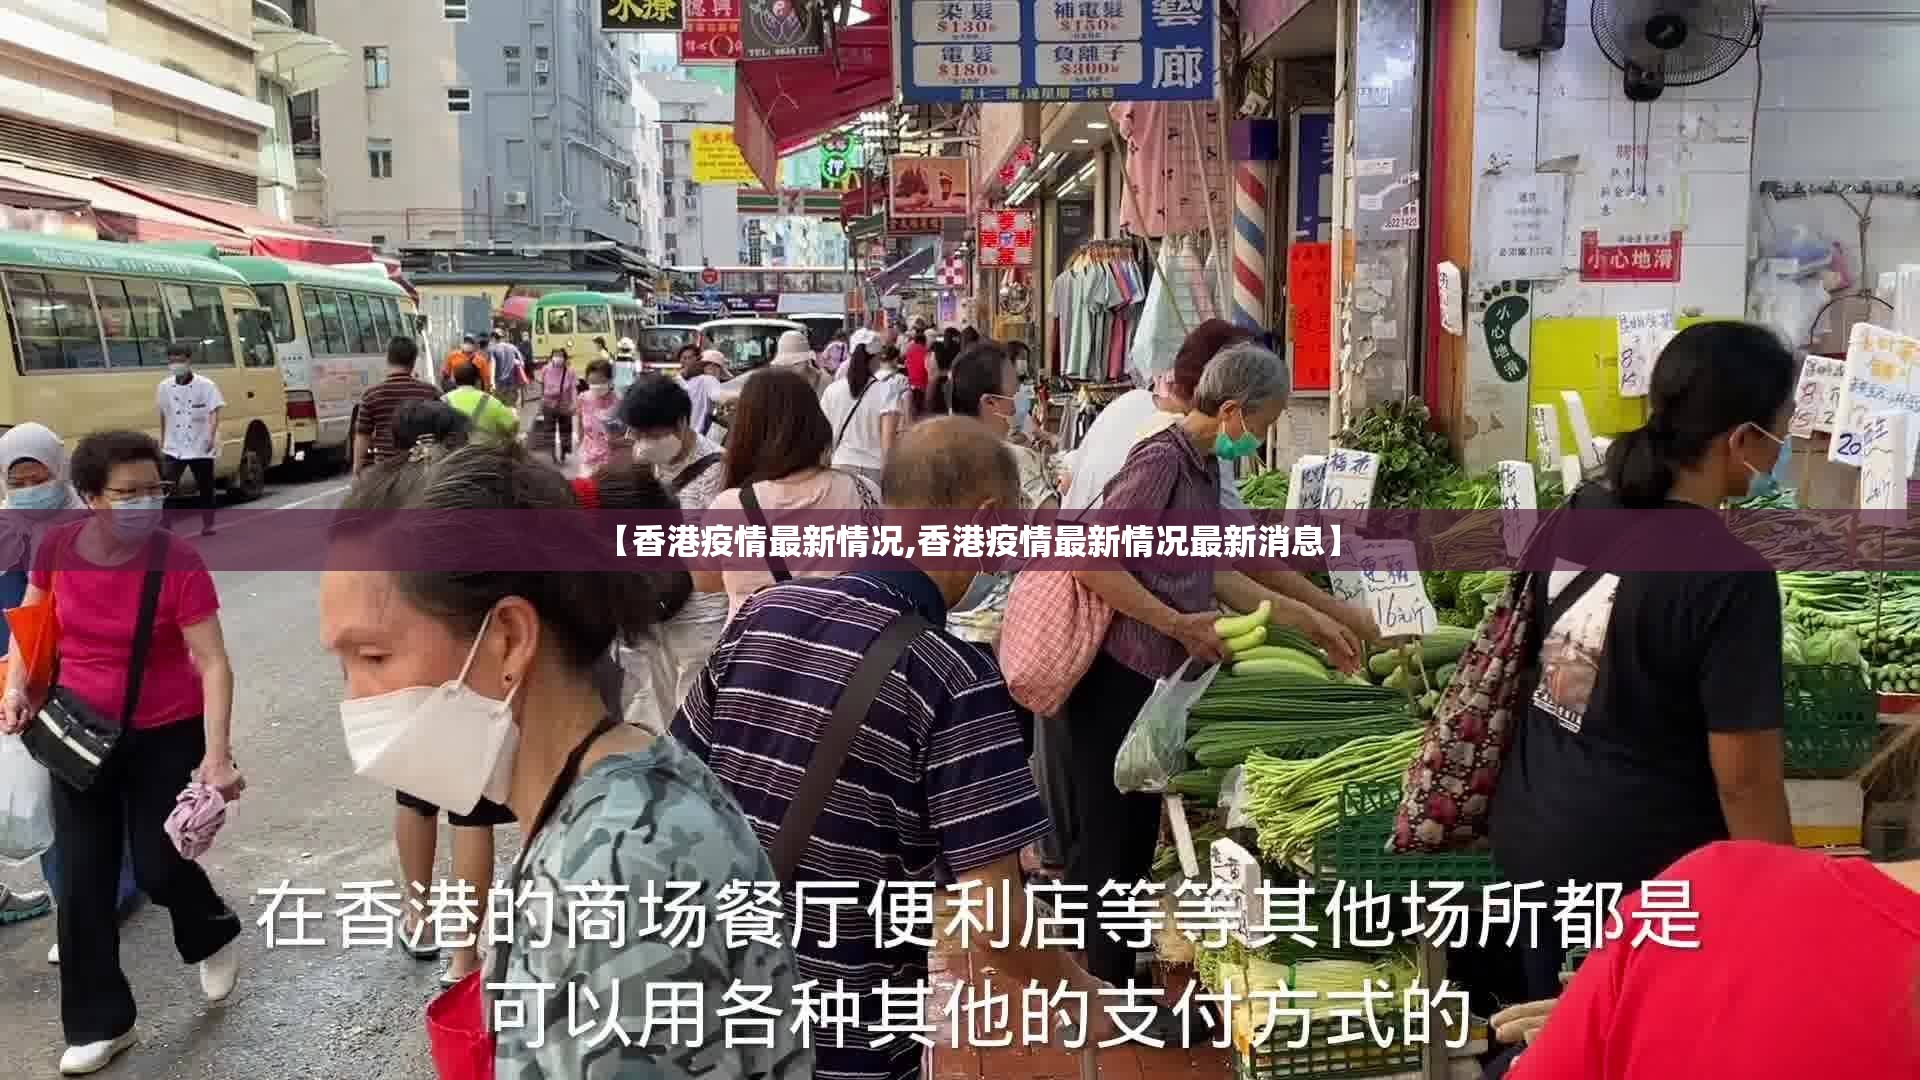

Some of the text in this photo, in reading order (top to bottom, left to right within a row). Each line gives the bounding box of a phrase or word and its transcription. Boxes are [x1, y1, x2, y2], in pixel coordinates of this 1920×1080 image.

[1587, 248, 1674, 270] 小心地滑
[1838, 433, 1861, 455] 20
